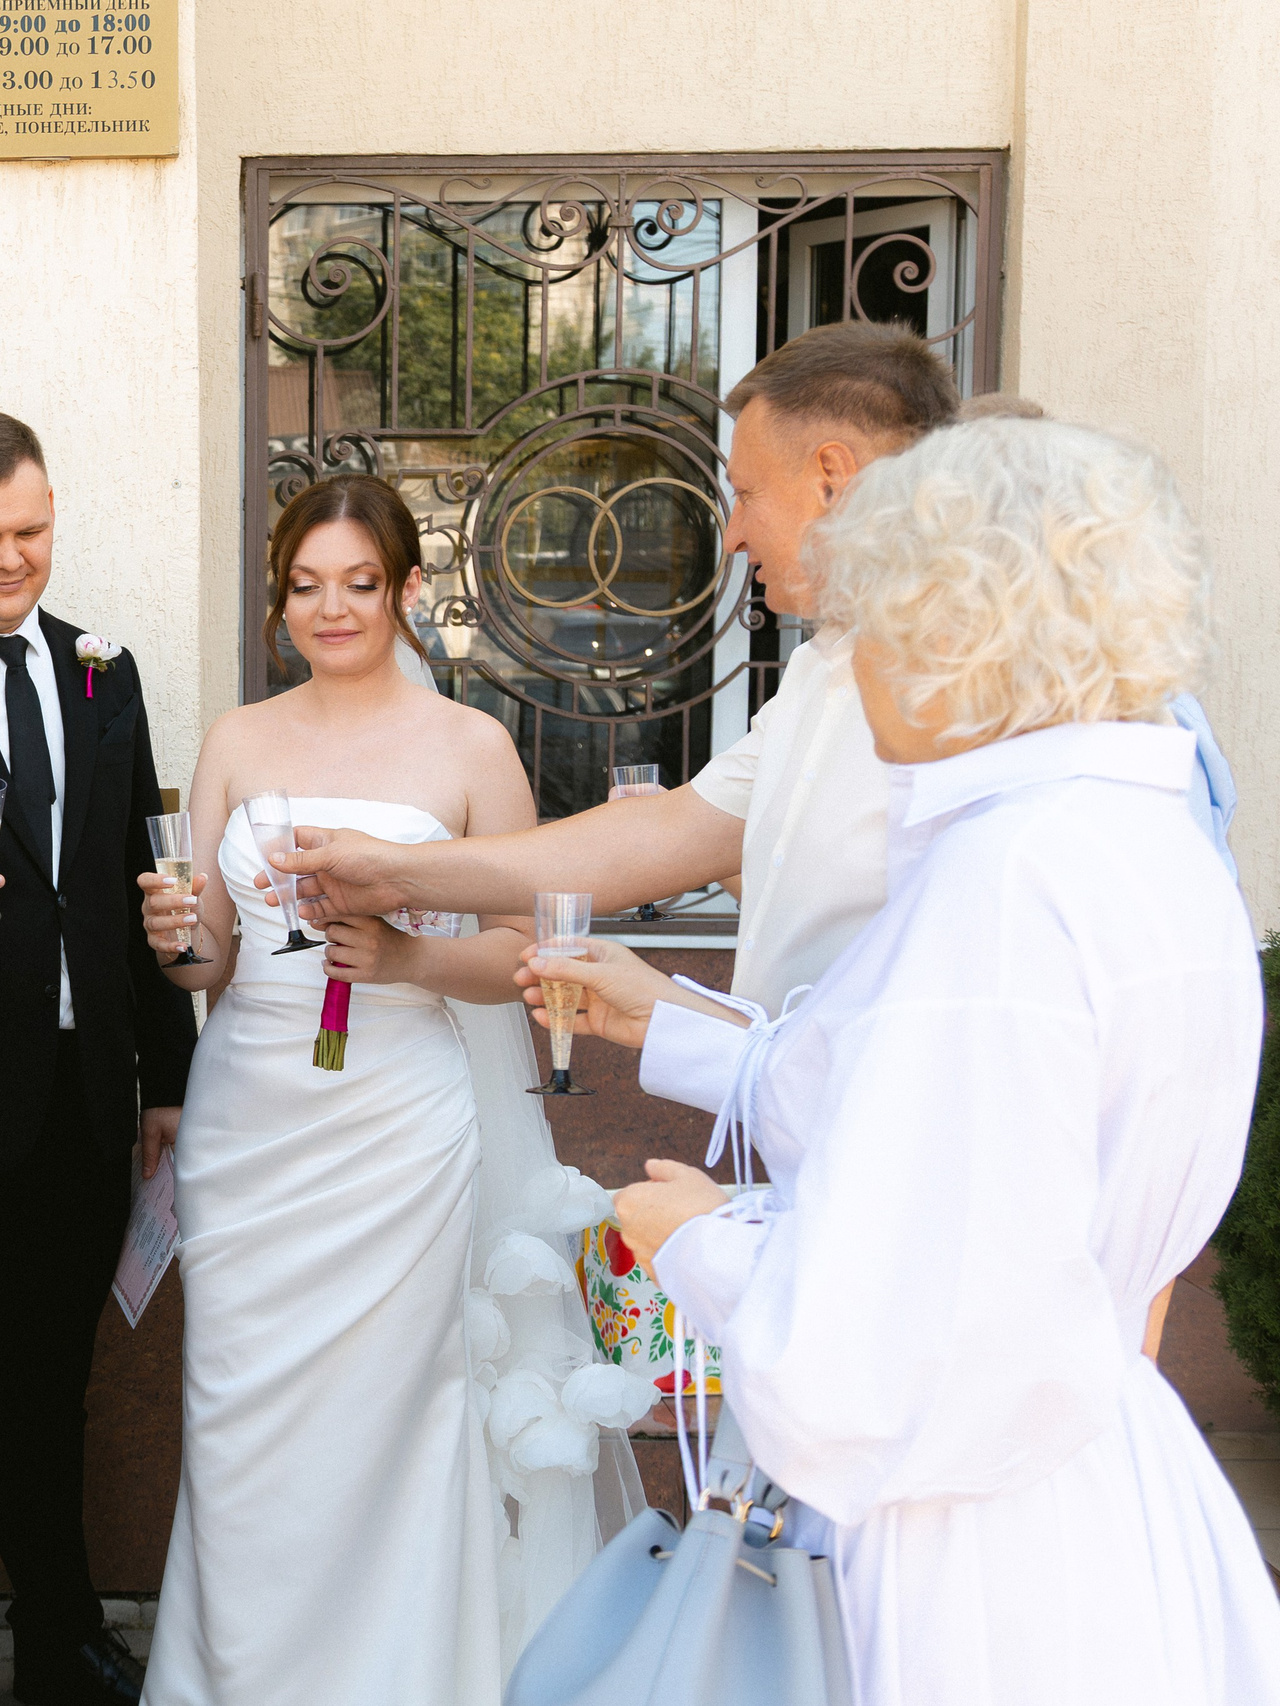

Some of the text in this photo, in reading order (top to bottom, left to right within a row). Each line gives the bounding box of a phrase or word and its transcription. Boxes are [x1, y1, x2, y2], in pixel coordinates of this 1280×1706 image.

[106, 0, 150, 11] ДЕНЬ
[0, 15, 46, 33] 9:00
[55, 20, 81, 34] до
[91, 14, 151, 32] 18:00
[87, 35, 152, 55] 17.00
[90, 70, 156, 89] 13.50
[49, 103, 93, 117] ДНИ:
[15, 119, 150, 135] ПОНЕДЕЛЬНИК
